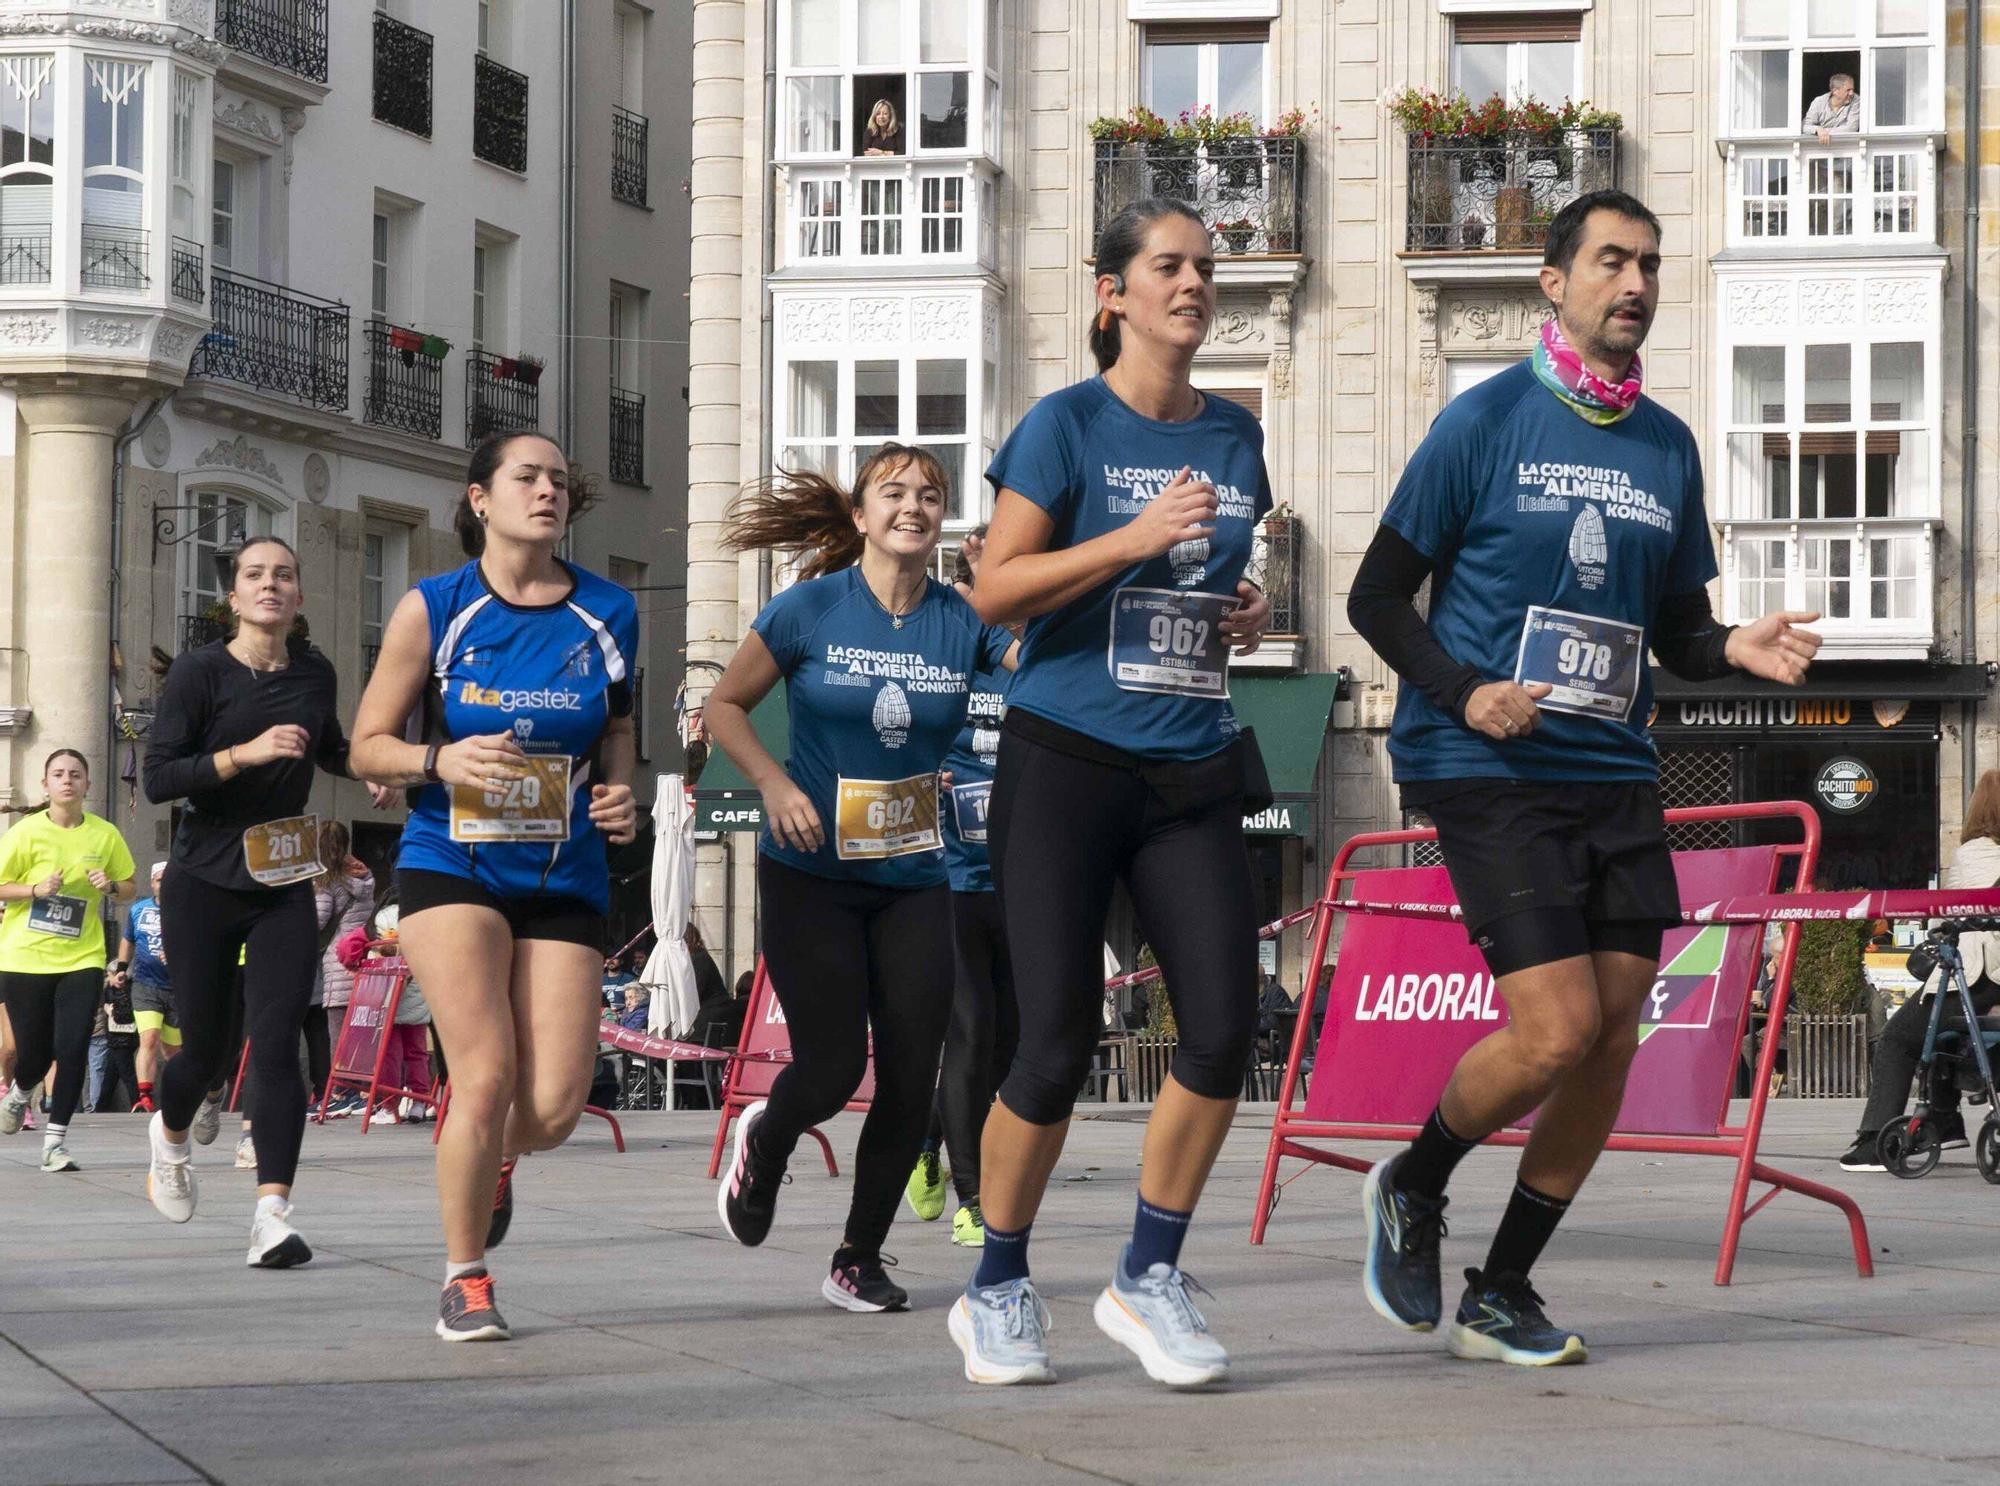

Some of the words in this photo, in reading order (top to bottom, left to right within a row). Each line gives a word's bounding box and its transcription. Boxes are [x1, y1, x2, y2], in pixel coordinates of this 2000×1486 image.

[1104, 464, 1122, 479] LA
[1518, 463, 1538, 476] LA
[1540, 463, 1631, 486] CONQUISTA
[1106, 478, 1118, 486] DE
[1120, 480, 1132, 488] LA
[1518, 476, 1532, 485] DE
[1534, 476, 1546, 485] LA
[1544, 478, 1658, 512] ALMENDRA
[1528, 495, 1568, 512] Edición
[1606, 503, 1672, 533] KONKISTA
[1148, 615, 1209, 656] 962
[827, 644, 845, 657] LA
[846, 648, 925, 666] CONQUISTA
[1558, 638, 1612, 680] 978
[833, 672, 871, 687] Edición
[839, 657, 850, 665] LA
[848, 660, 952, 681] ALMENDRA
[907, 680, 968, 693] KONKISTA
[1569, 679, 1596, 690] SERGIO
[711, 808, 760, 822] CAFÉ
[868, 796, 915, 830] 692
[1242, 808, 1291, 829] AGNA
[269, 832, 302, 860] 261
[46, 902, 72, 921] 750
[1771, 908, 1813, 919] LABORAL
[1355, 972, 1498, 1021] LABORAL
